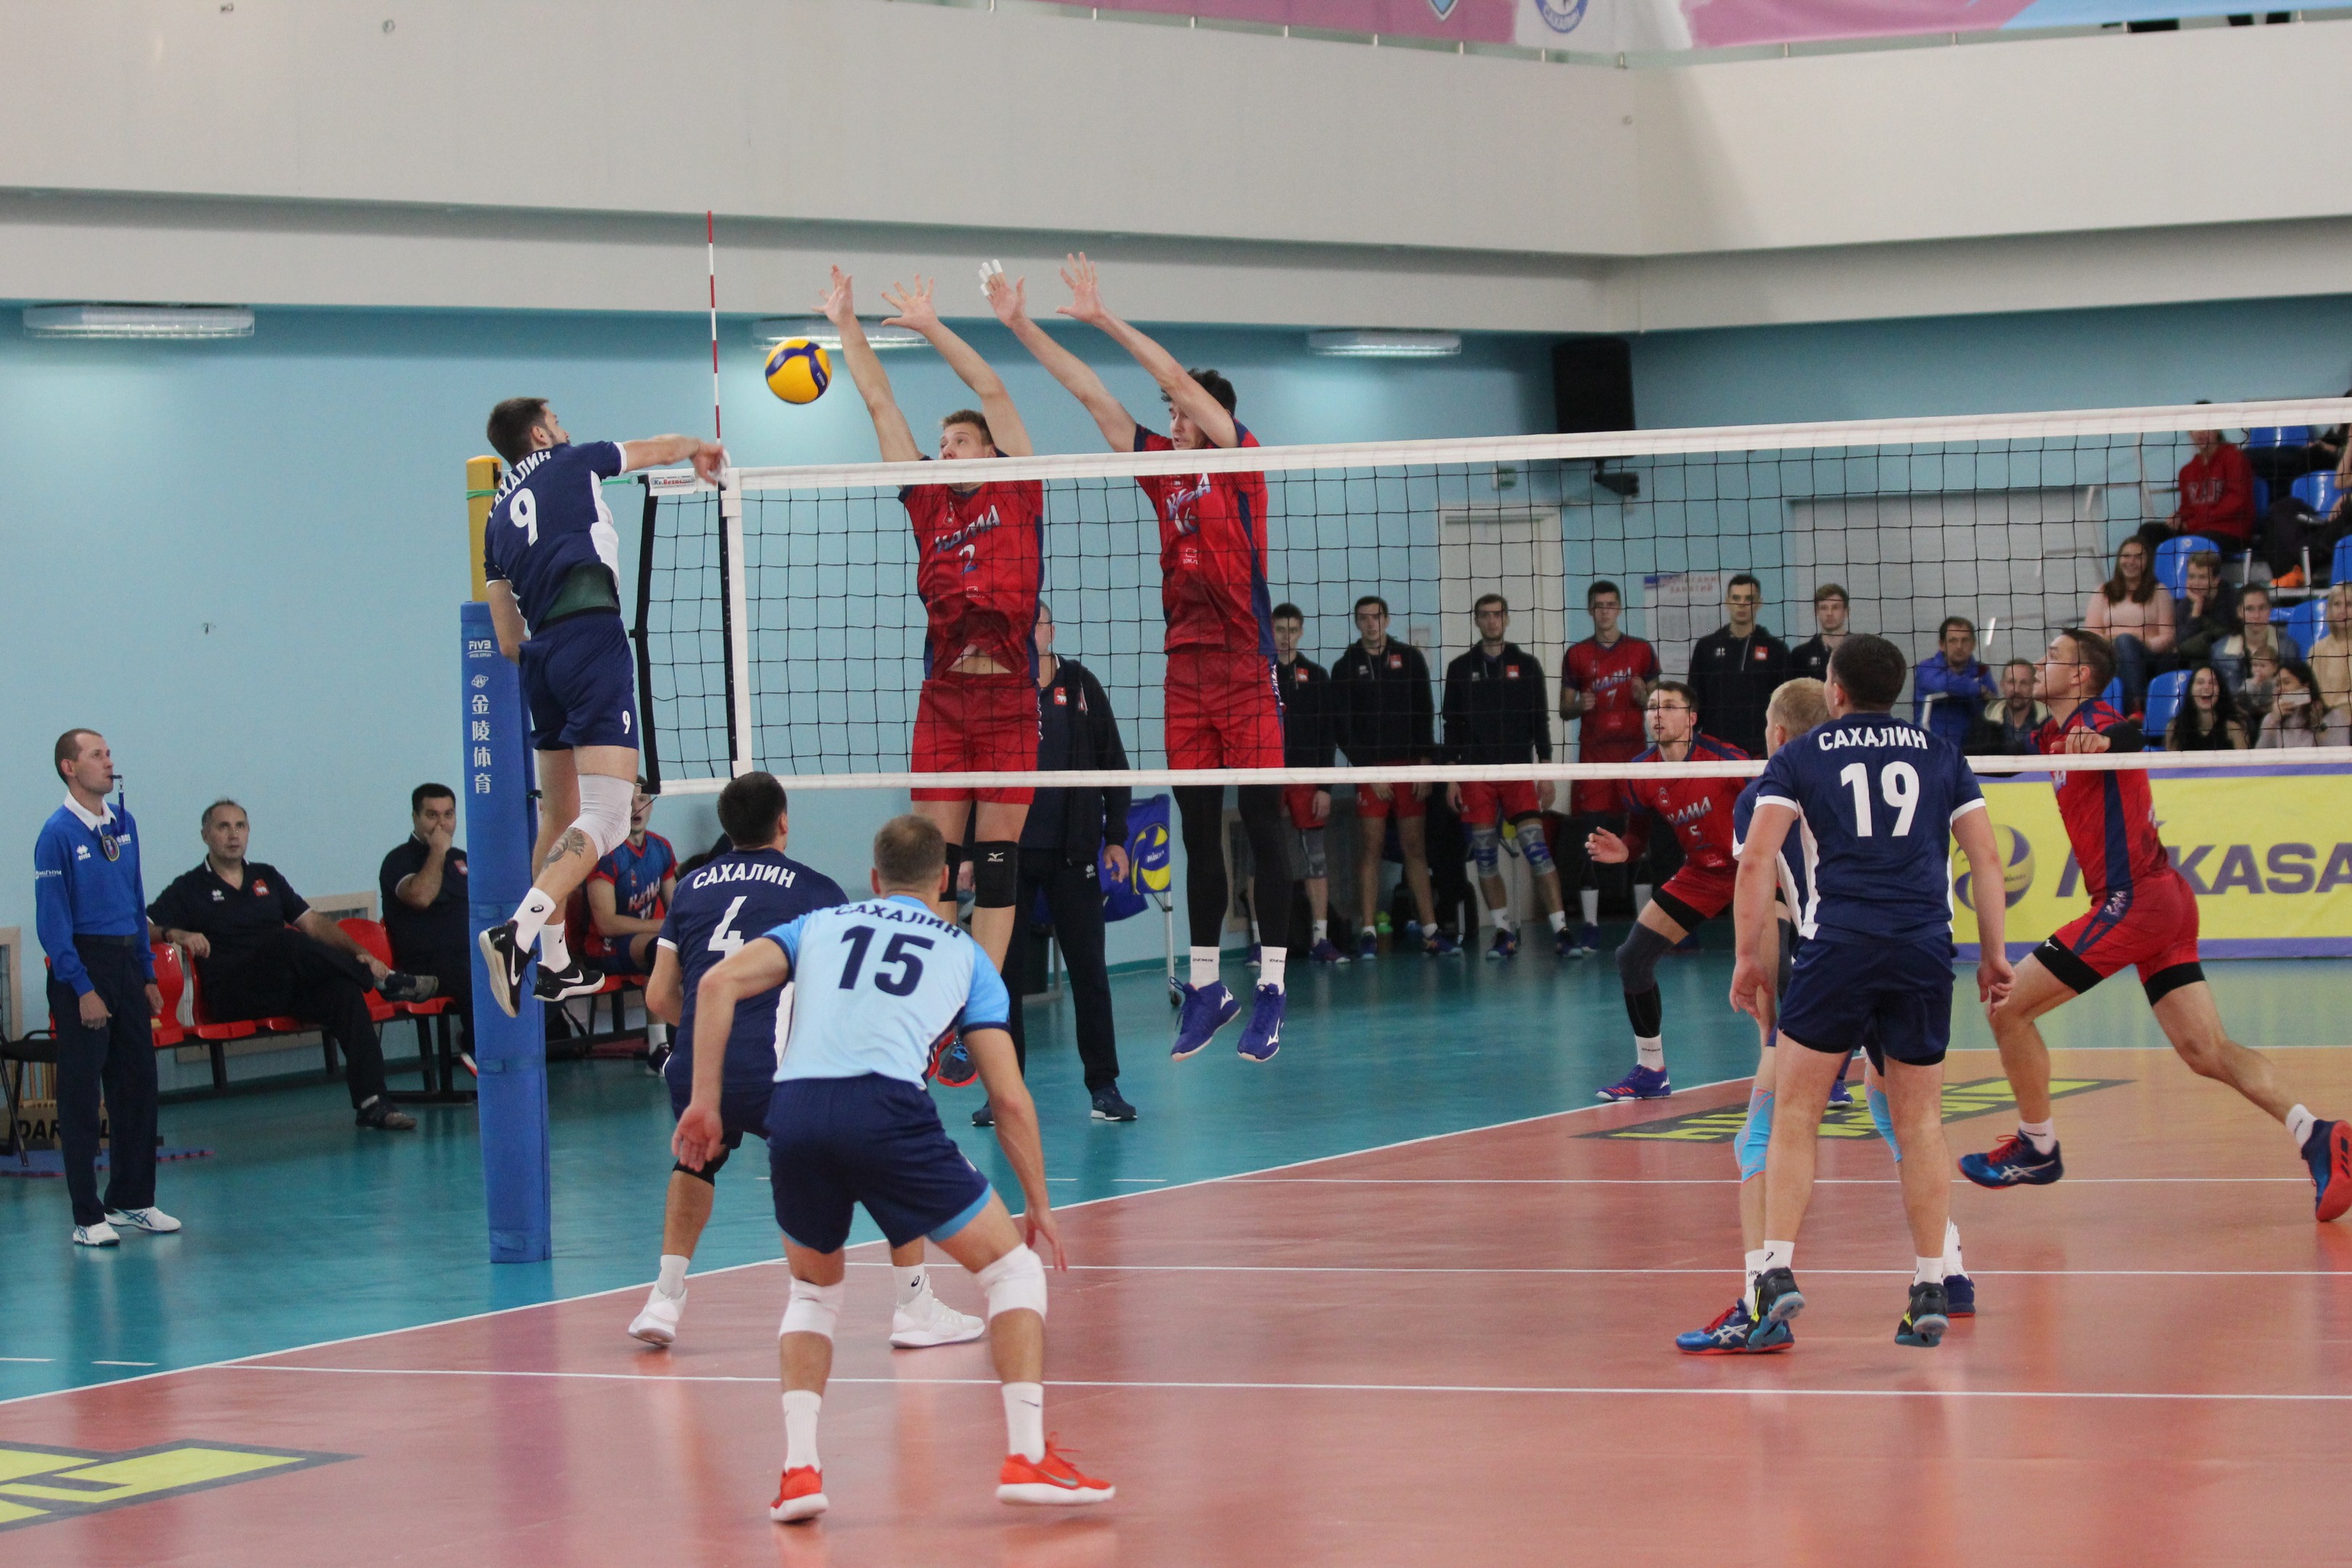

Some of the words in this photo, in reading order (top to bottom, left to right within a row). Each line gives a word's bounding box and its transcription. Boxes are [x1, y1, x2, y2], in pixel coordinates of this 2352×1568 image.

[489, 451, 552, 518] АХАЛИН
[510, 487, 539, 547] 9
[958, 543, 979, 576] 2
[468, 639, 492, 650] FIVB
[1606, 687, 1617, 709] 7
[622, 710, 631, 734] 9
[1818, 726, 1928, 751] САХАЛИН
[471, 694, 492, 794] 金陵体育
[1839, 760, 1921, 838] 19
[1689, 825, 1703, 843] 5
[693, 862, 796, 889] САХАЛИН
[2055, 842, 2352, 897] KASA
[707, 895, 748, 961] 4
[834, 904, 962, 939] САХАЛИН
[838, 924, 935, 997] 15
